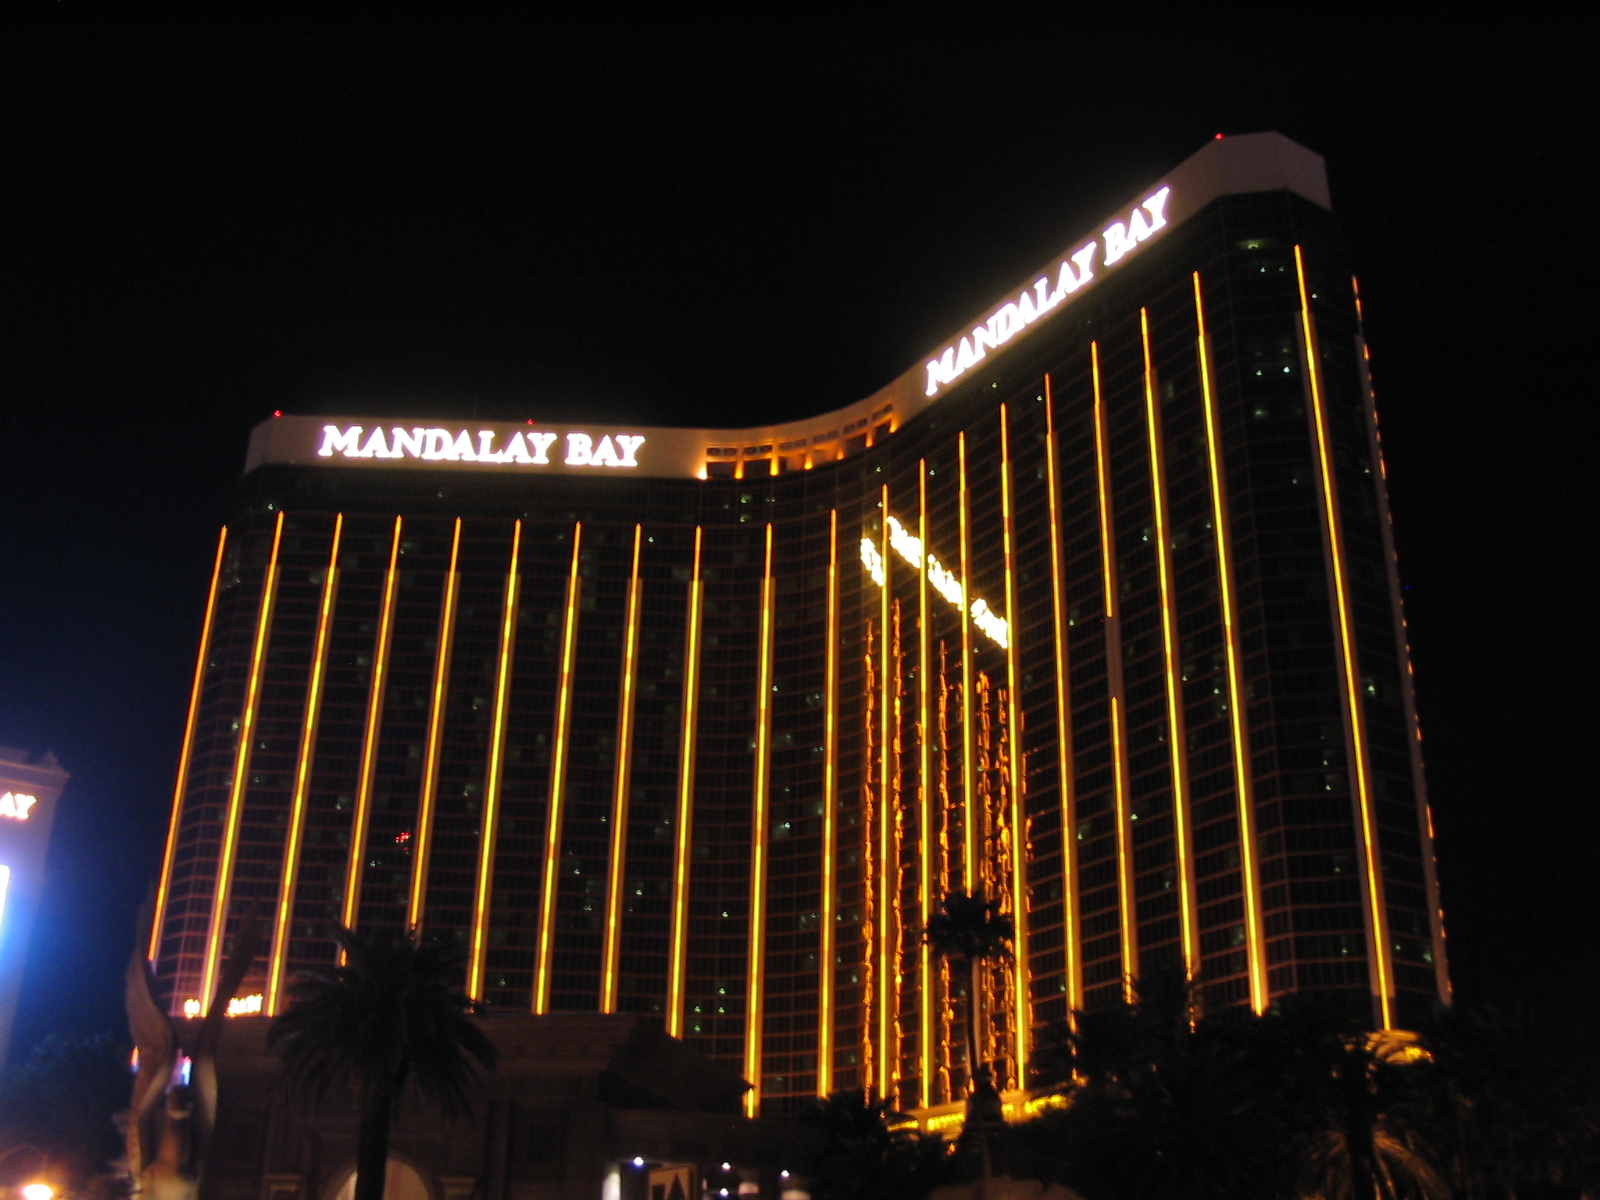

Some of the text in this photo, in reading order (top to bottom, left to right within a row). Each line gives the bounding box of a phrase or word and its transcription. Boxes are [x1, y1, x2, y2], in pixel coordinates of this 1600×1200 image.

[925, 186, 1170, 397] MANDALAY BAY
[317, 424, 645, 467] MANDALAY BAY
